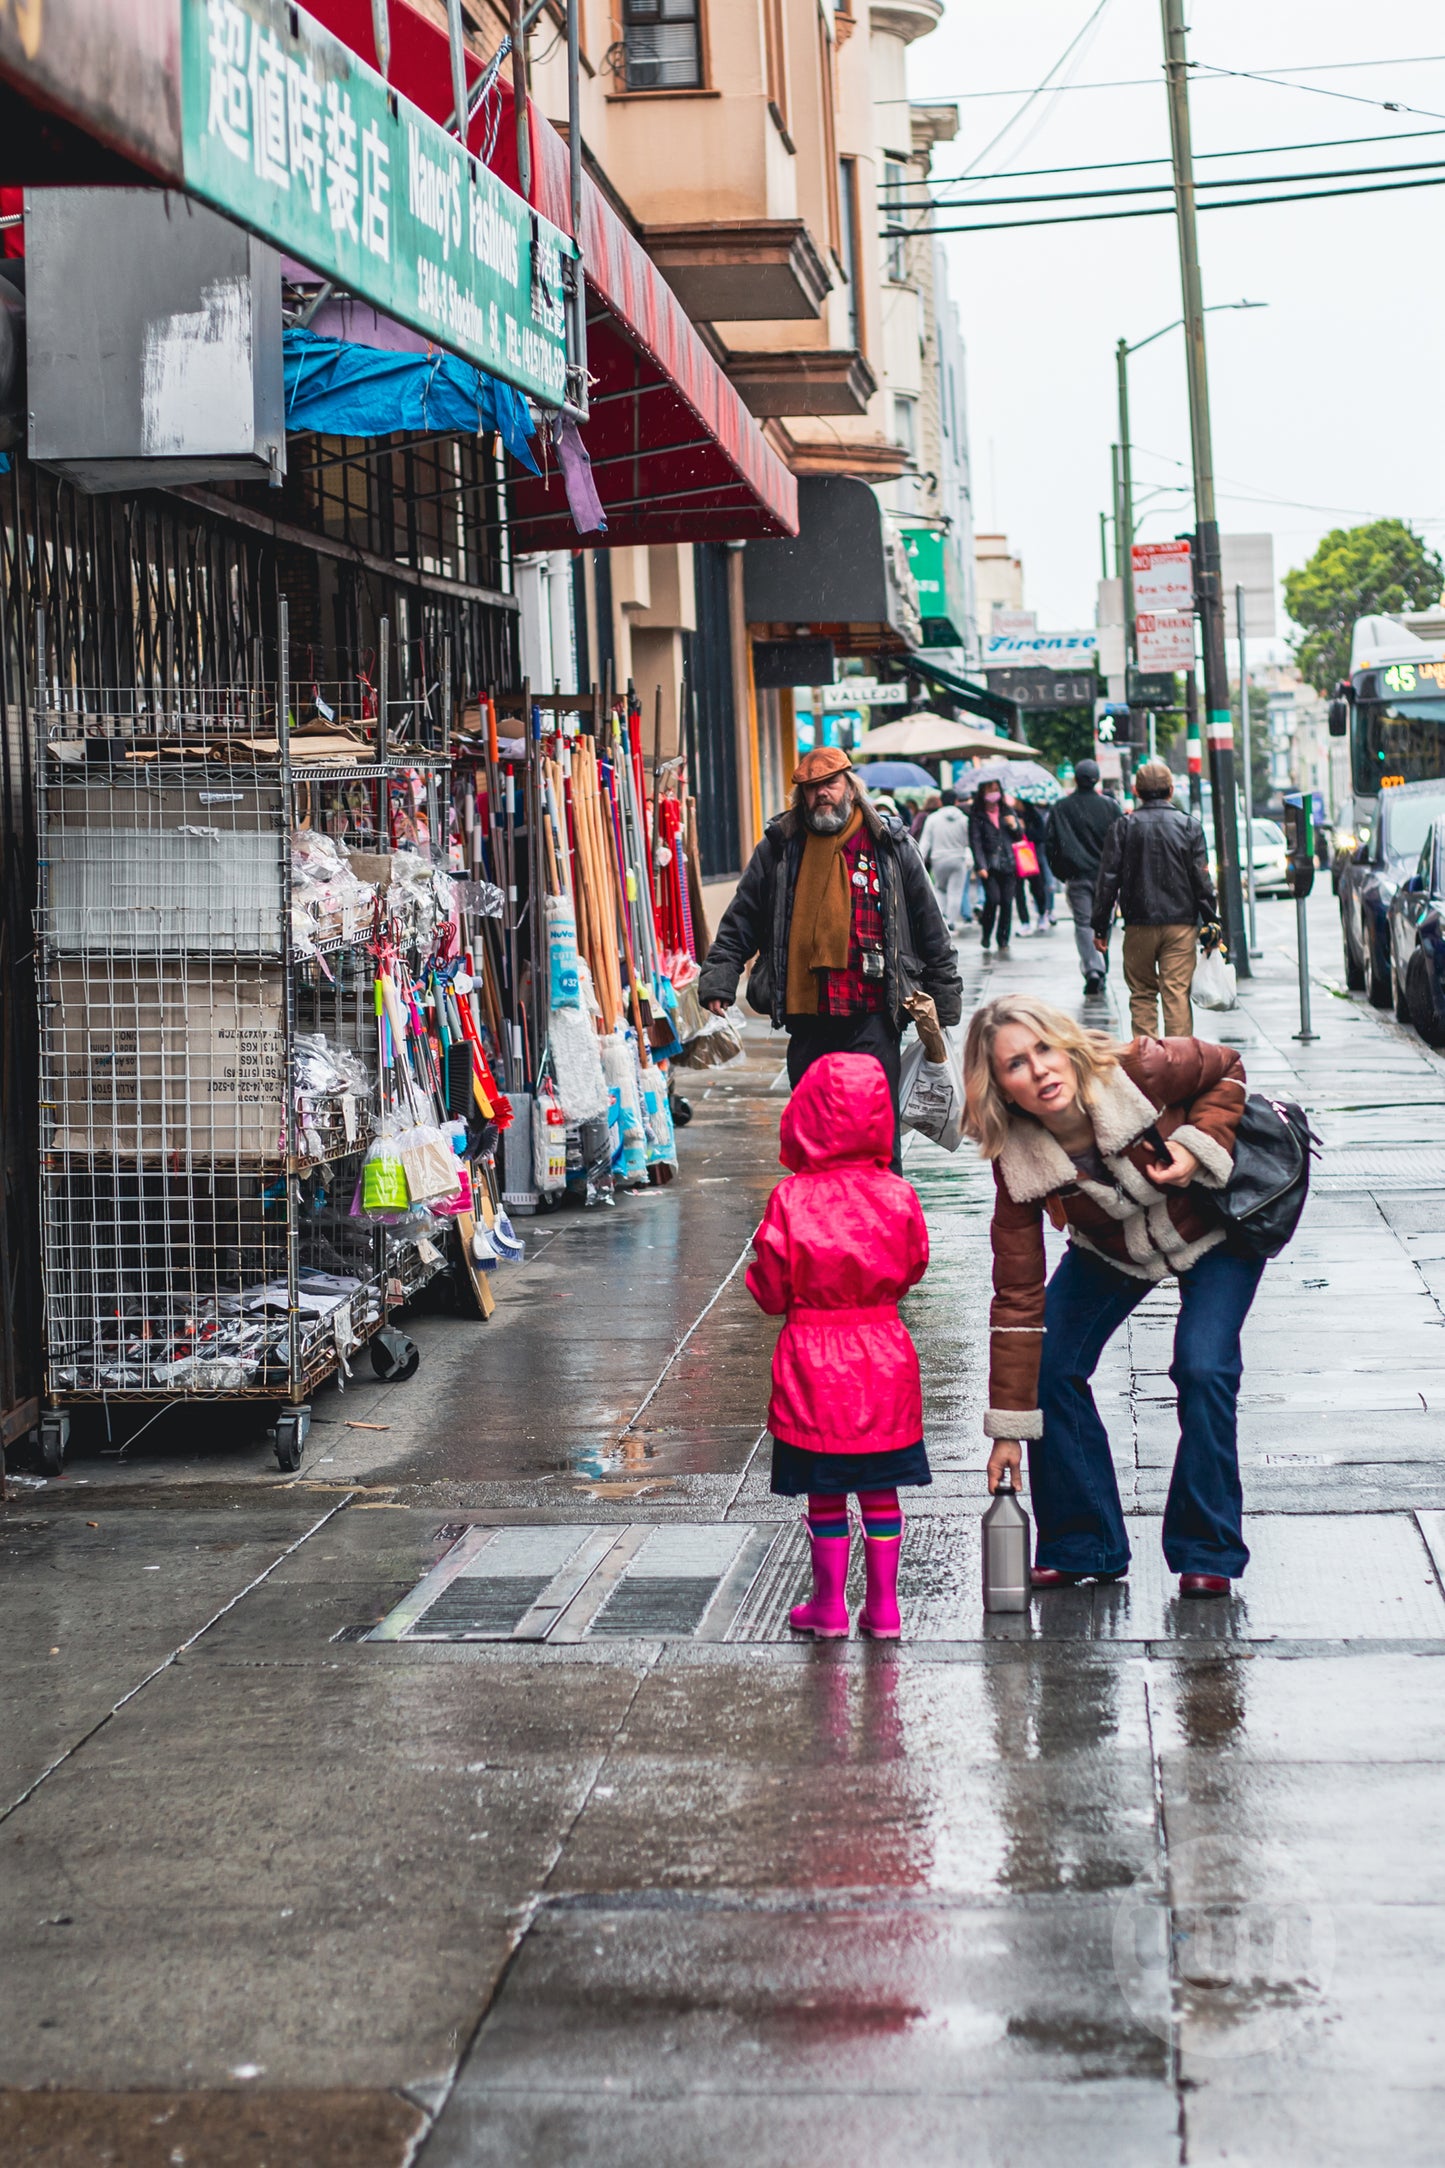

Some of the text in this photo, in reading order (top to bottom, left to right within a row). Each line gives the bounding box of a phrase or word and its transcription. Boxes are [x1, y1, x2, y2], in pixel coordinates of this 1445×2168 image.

[207, 0, 390, 264] 超值時裝店
[469, 180, 519, 288] Fashions
[449, 277, 484, 345] Stockton
[505, 313, 522, 369] TEL:
[1133, 556, 1150, 569] NO
[1138, 617, 1192, 630] NO PARKING
[988, 636, 1096, 652] Firenze
[1385, 665, 1416, 692] 45
[829, 688, 901, 702] VALLEJO
[562, 978, 578, 987] #32
[240, 1043, 258, 1052] KGS
[240, 1056, 258, 1065] KGS
[92, 1084, 137, 1093] ALLIGTON
